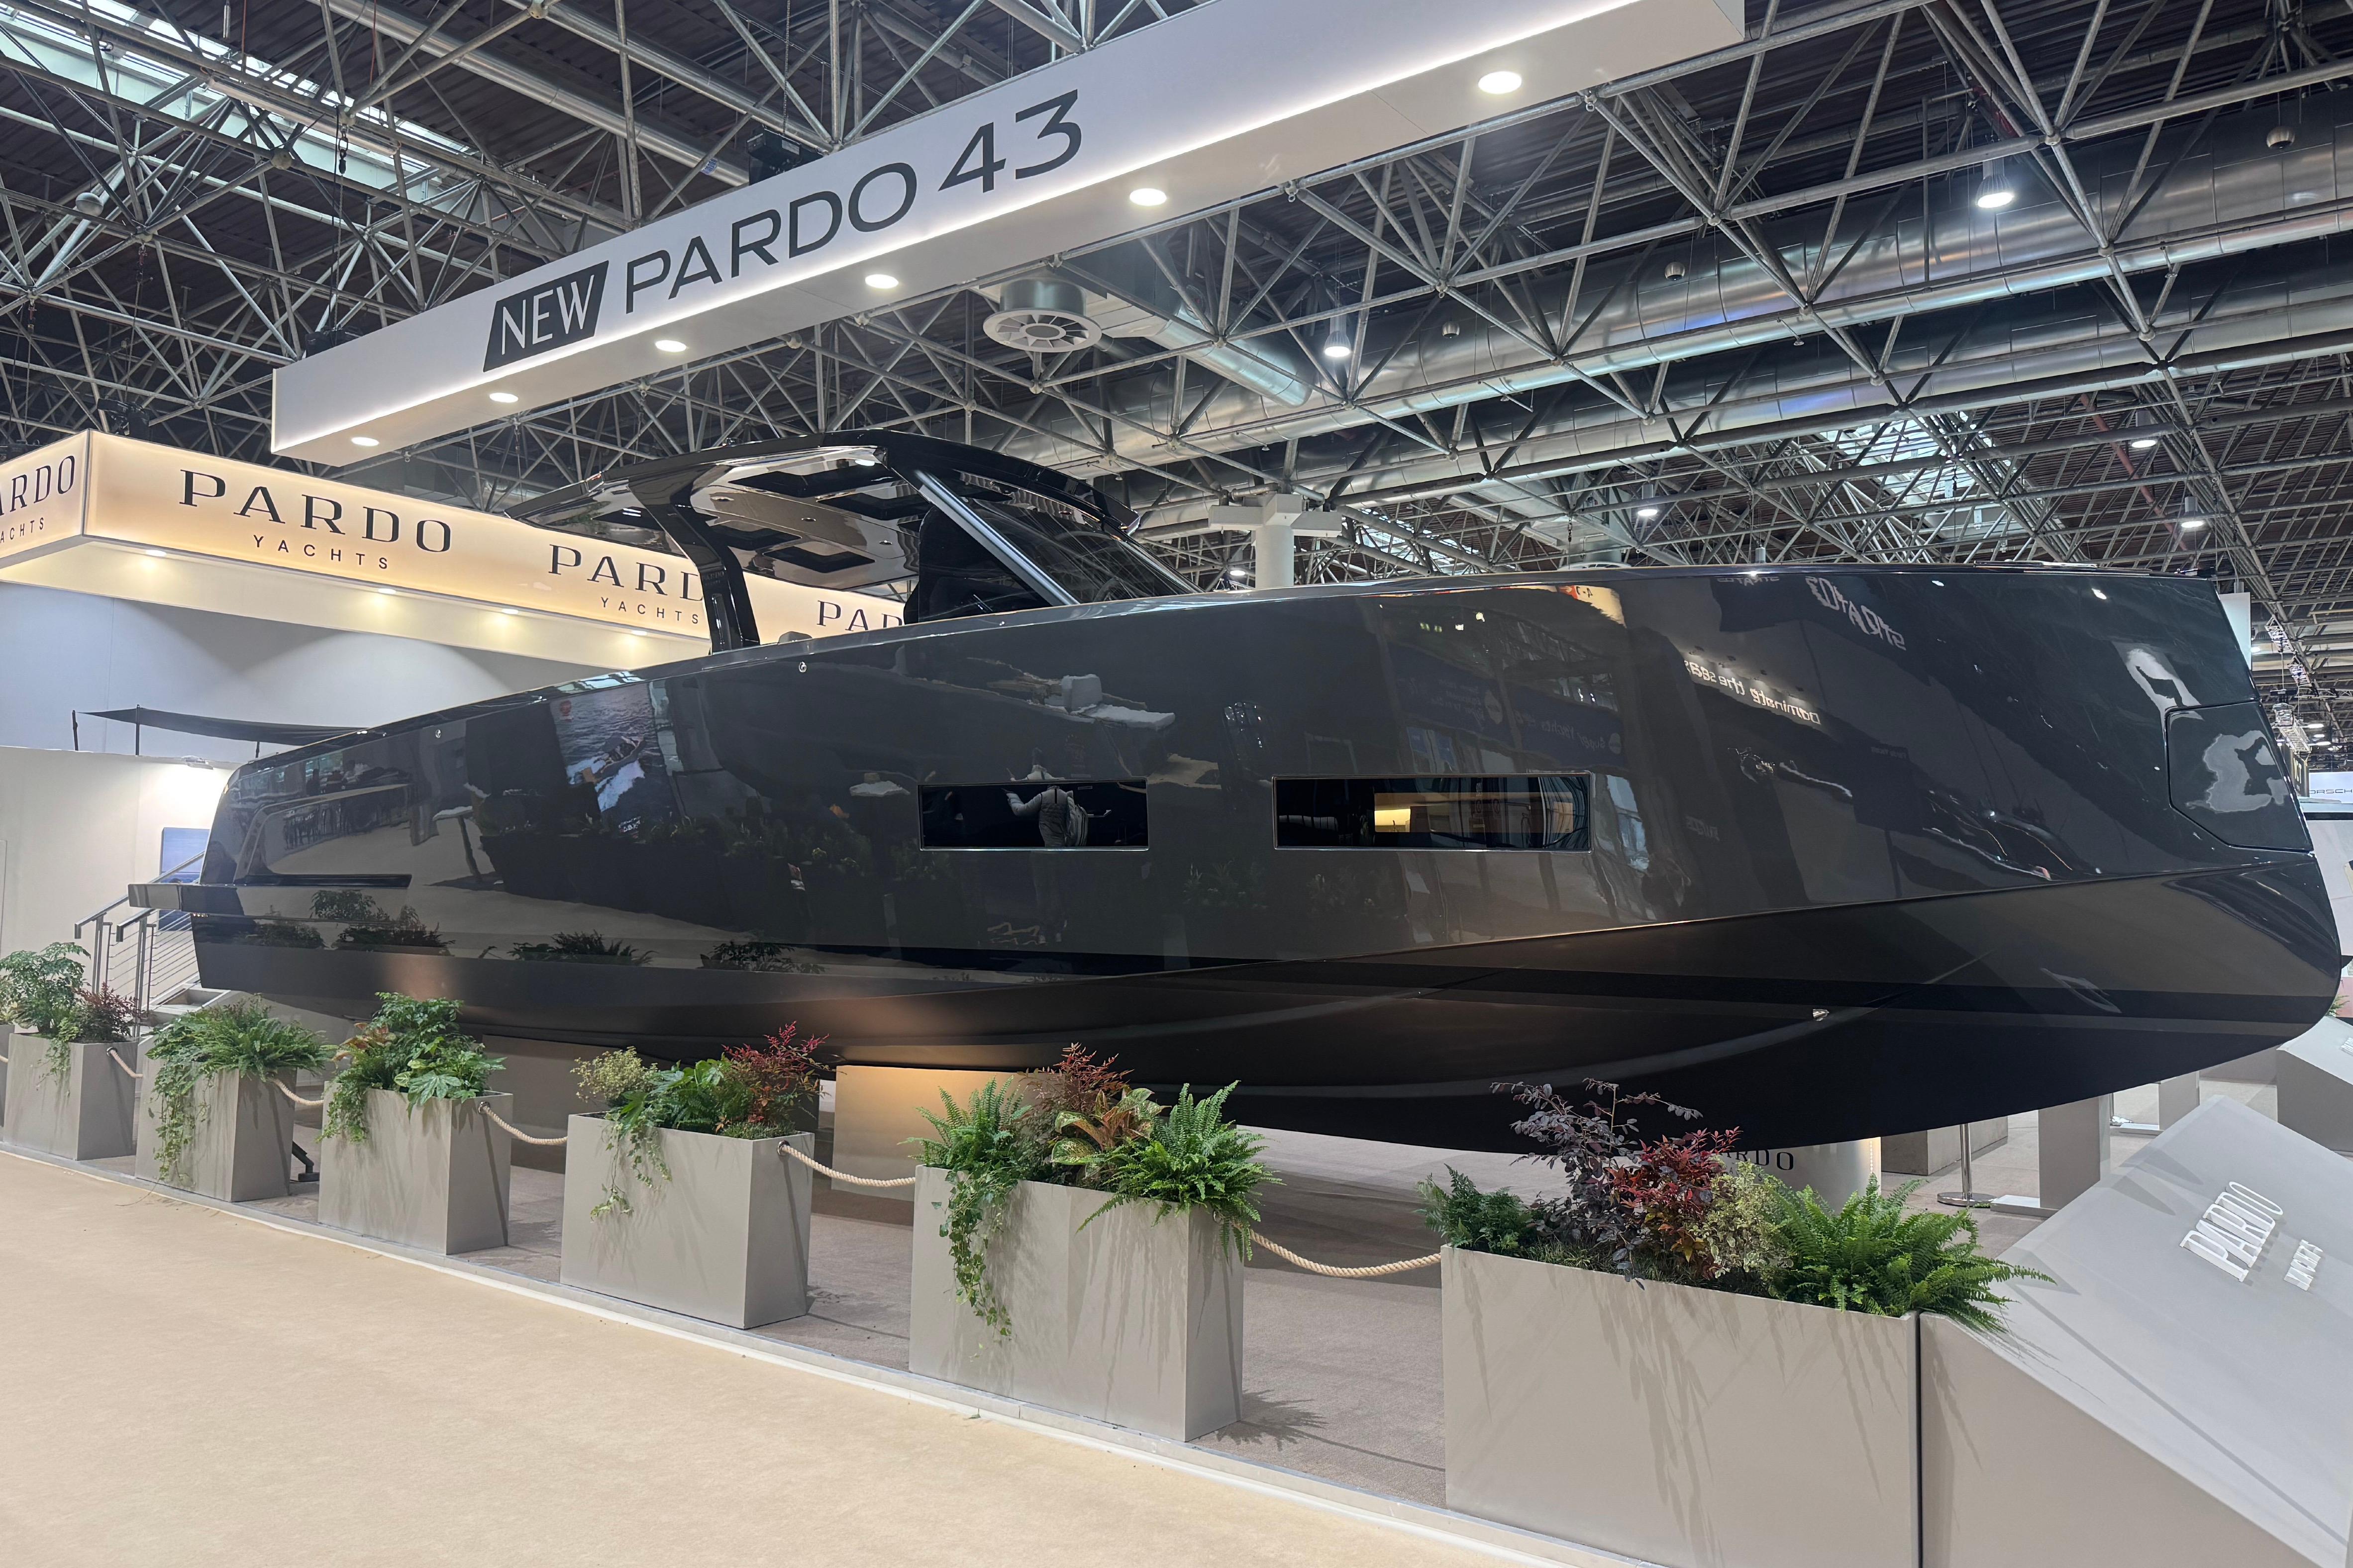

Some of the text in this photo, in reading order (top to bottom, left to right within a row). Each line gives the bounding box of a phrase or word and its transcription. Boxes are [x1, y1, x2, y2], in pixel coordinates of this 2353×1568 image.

[502, 89, 1082, 355] NEW PARDO 43
[0, 517, 44, 543] ACHTS
[179, 469, 451, 553] PARDO
[253, 535, 388, 570] YACHTS
[548, 544, 703, 601] PARD
[601, 596, 699, 624] YACHTS
[2179, 1181, 2283, 1282] PARDO
